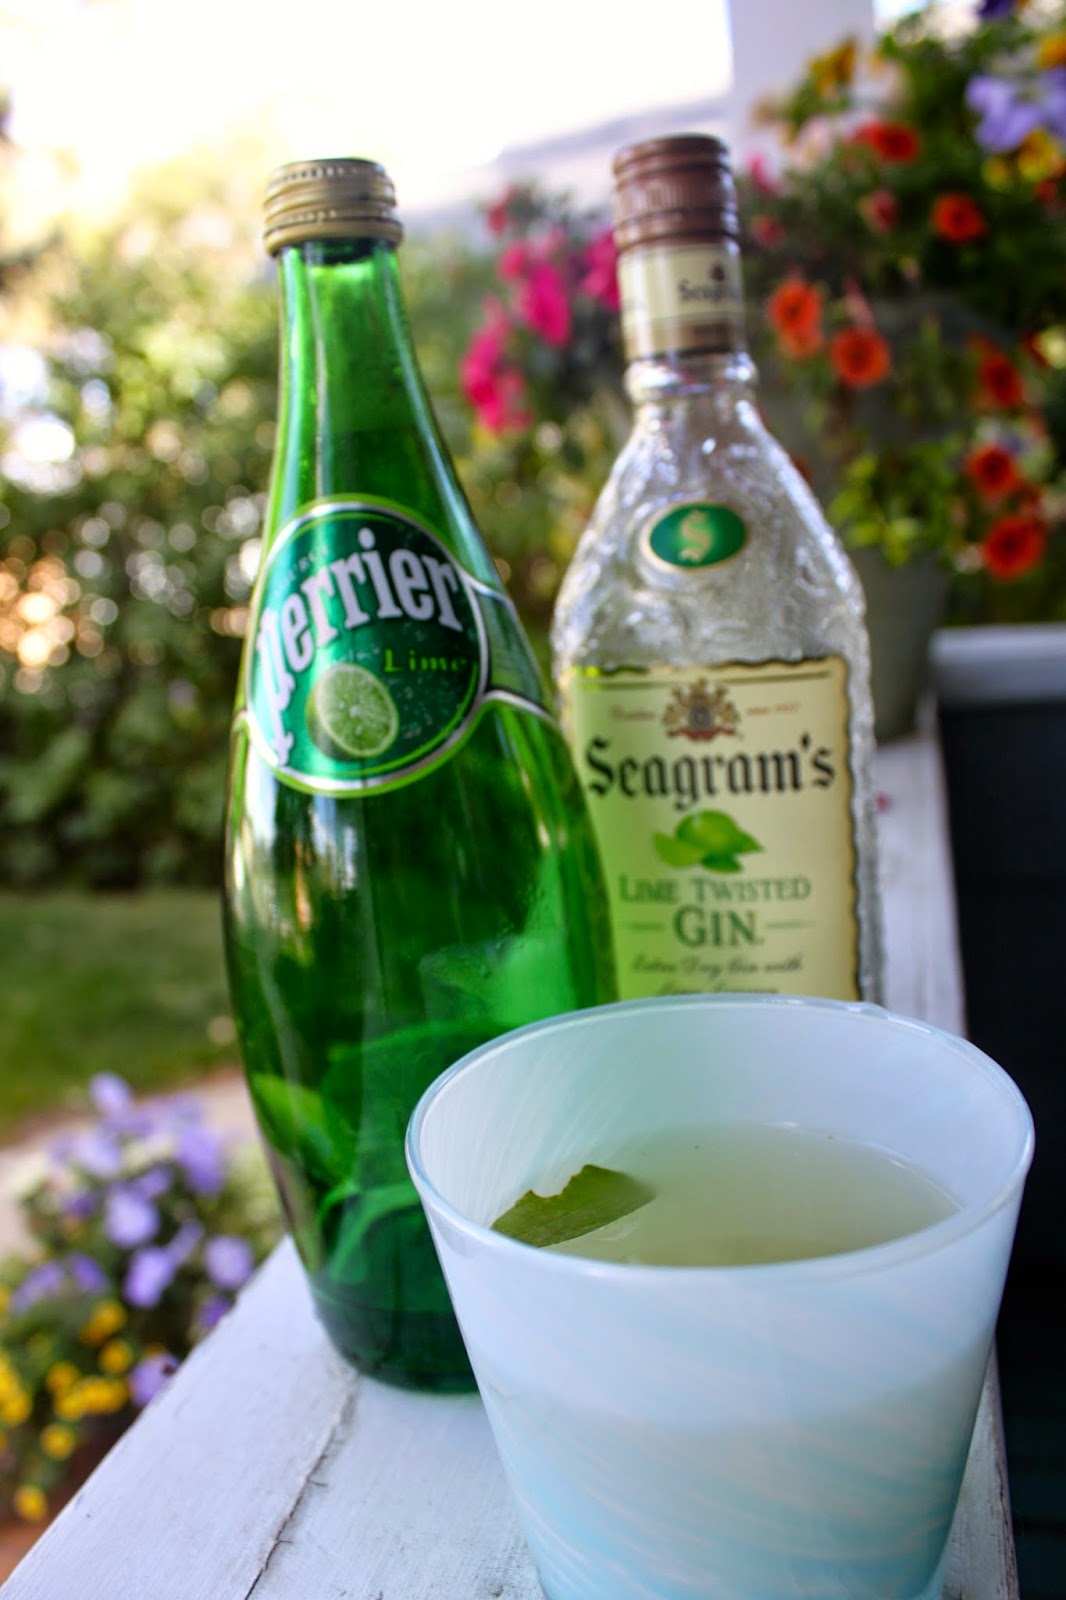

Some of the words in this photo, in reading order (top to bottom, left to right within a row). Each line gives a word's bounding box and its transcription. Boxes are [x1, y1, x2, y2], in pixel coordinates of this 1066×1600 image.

[384, 649, 467, 673] Lime
[585, 731, 836, 812] Seagram's
[692, 875, 812, 903] TWISTED
